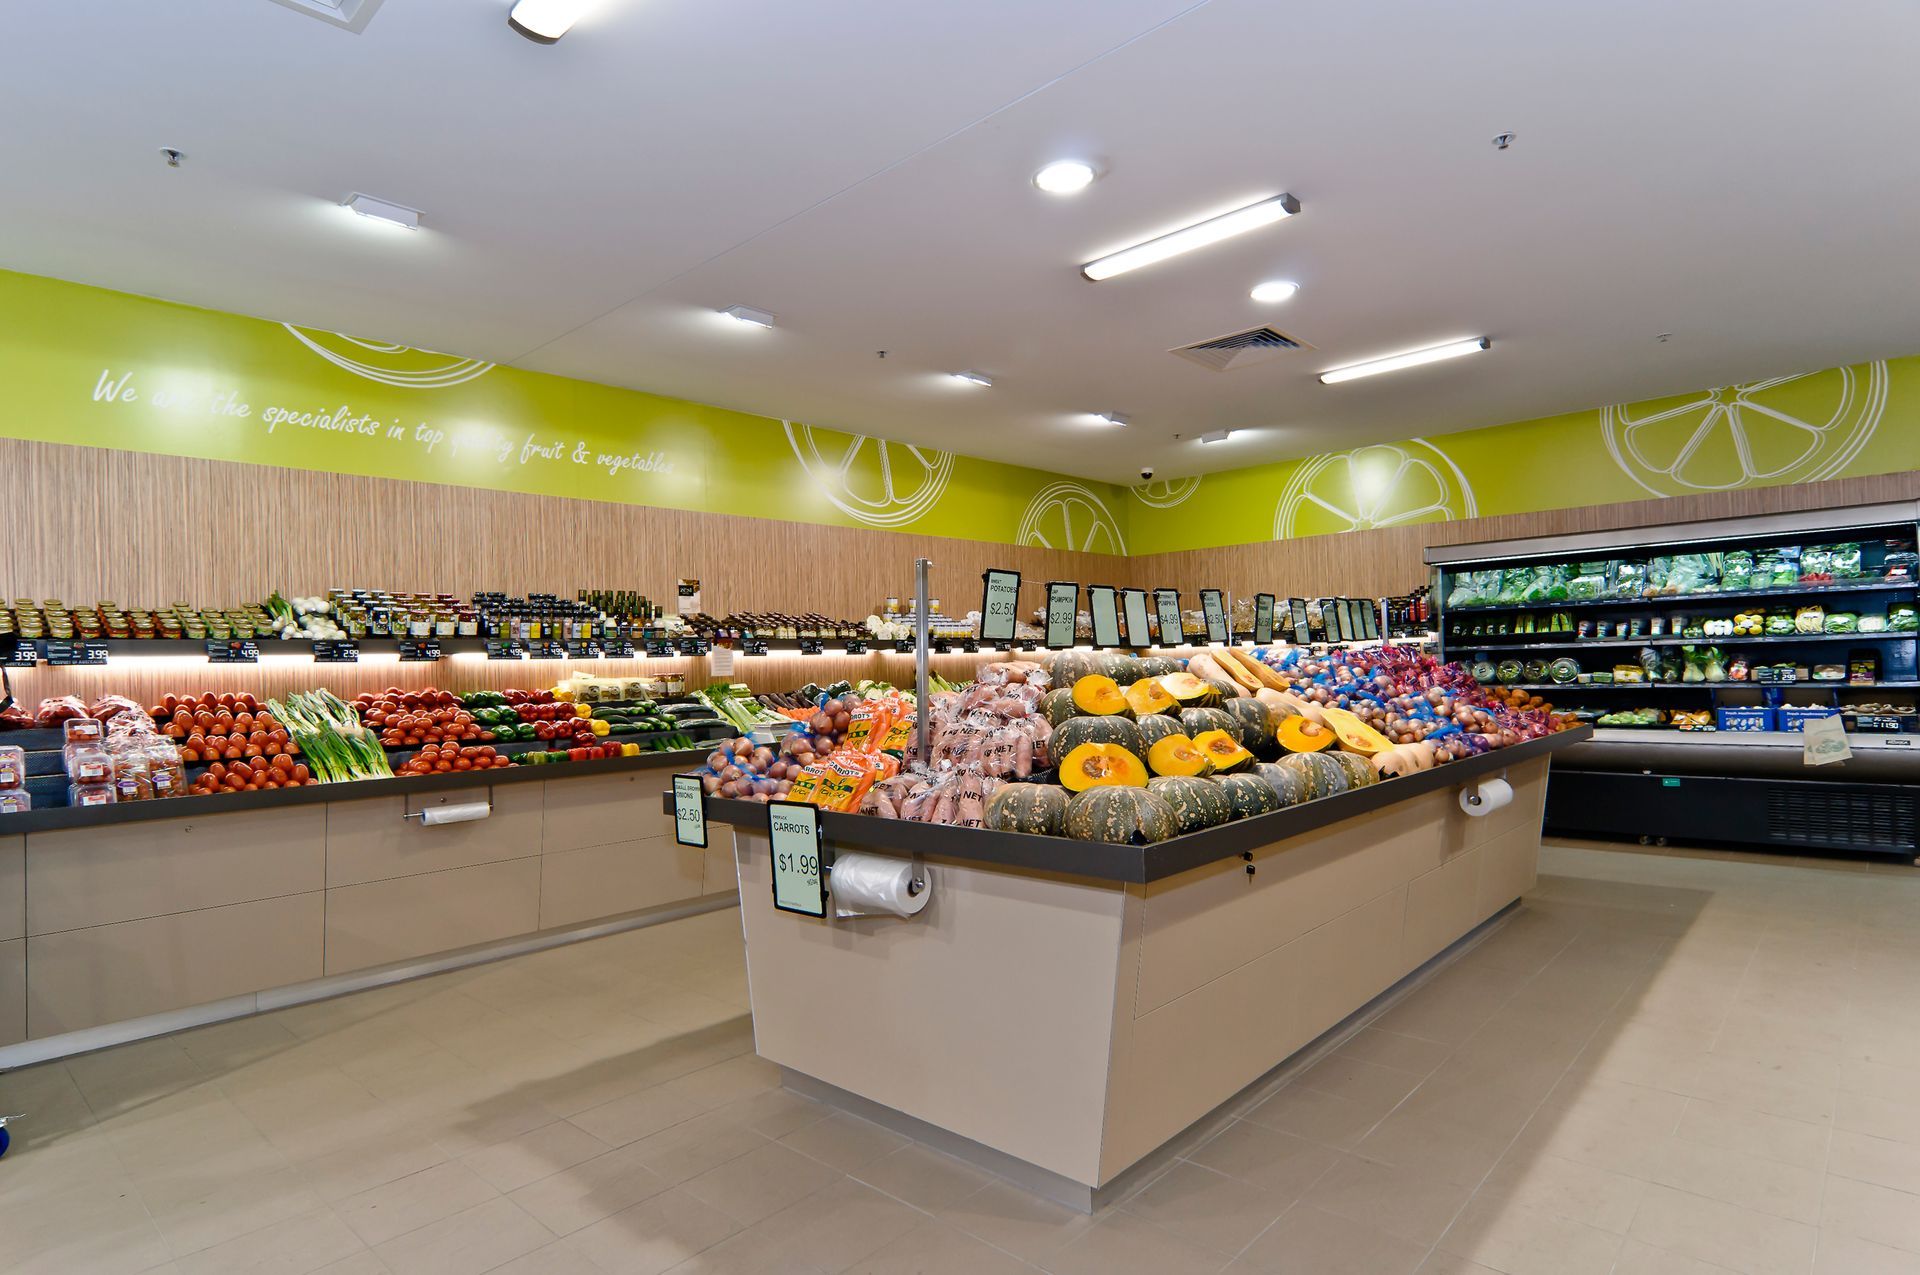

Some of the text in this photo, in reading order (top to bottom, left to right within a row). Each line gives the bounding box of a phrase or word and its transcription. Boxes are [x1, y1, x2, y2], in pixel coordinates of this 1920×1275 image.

[92, 368, 138, 402] We
[209, 389, 252, 418] the
[262, 404, 381, 434] specialists
[387, 418, 404, 440] in
[415, 422, 443, 453] top
[520, 433, 565, 464] fruit
[572, 441, 591, 465] &
[597, 452, 675, 475] vegetables
[990, 585, 1017, 593] POTATOES
[990, 602, 1015, 616] $2.50
[1050, 612, 1073, 624] $2.99
[1160, 614, 1178, 624] $4.99
[15, 651, 37, 661] 3.99
[88, 649, 109, 659] 3.99
[241, 649, 259, 657] 4.99
[343, 649, 359, 657] 2.99
[426, 649, 440, 657] 4.99
[960, 727, 980, 735] NET
[994, 744, 1014, 755] NET
[963, 791, 983, 802] NET
[677, 808, 701, 822] $2.50
[773, 821, 810, 835] CARROTS
[779, 852, 818, 875] $1.99
